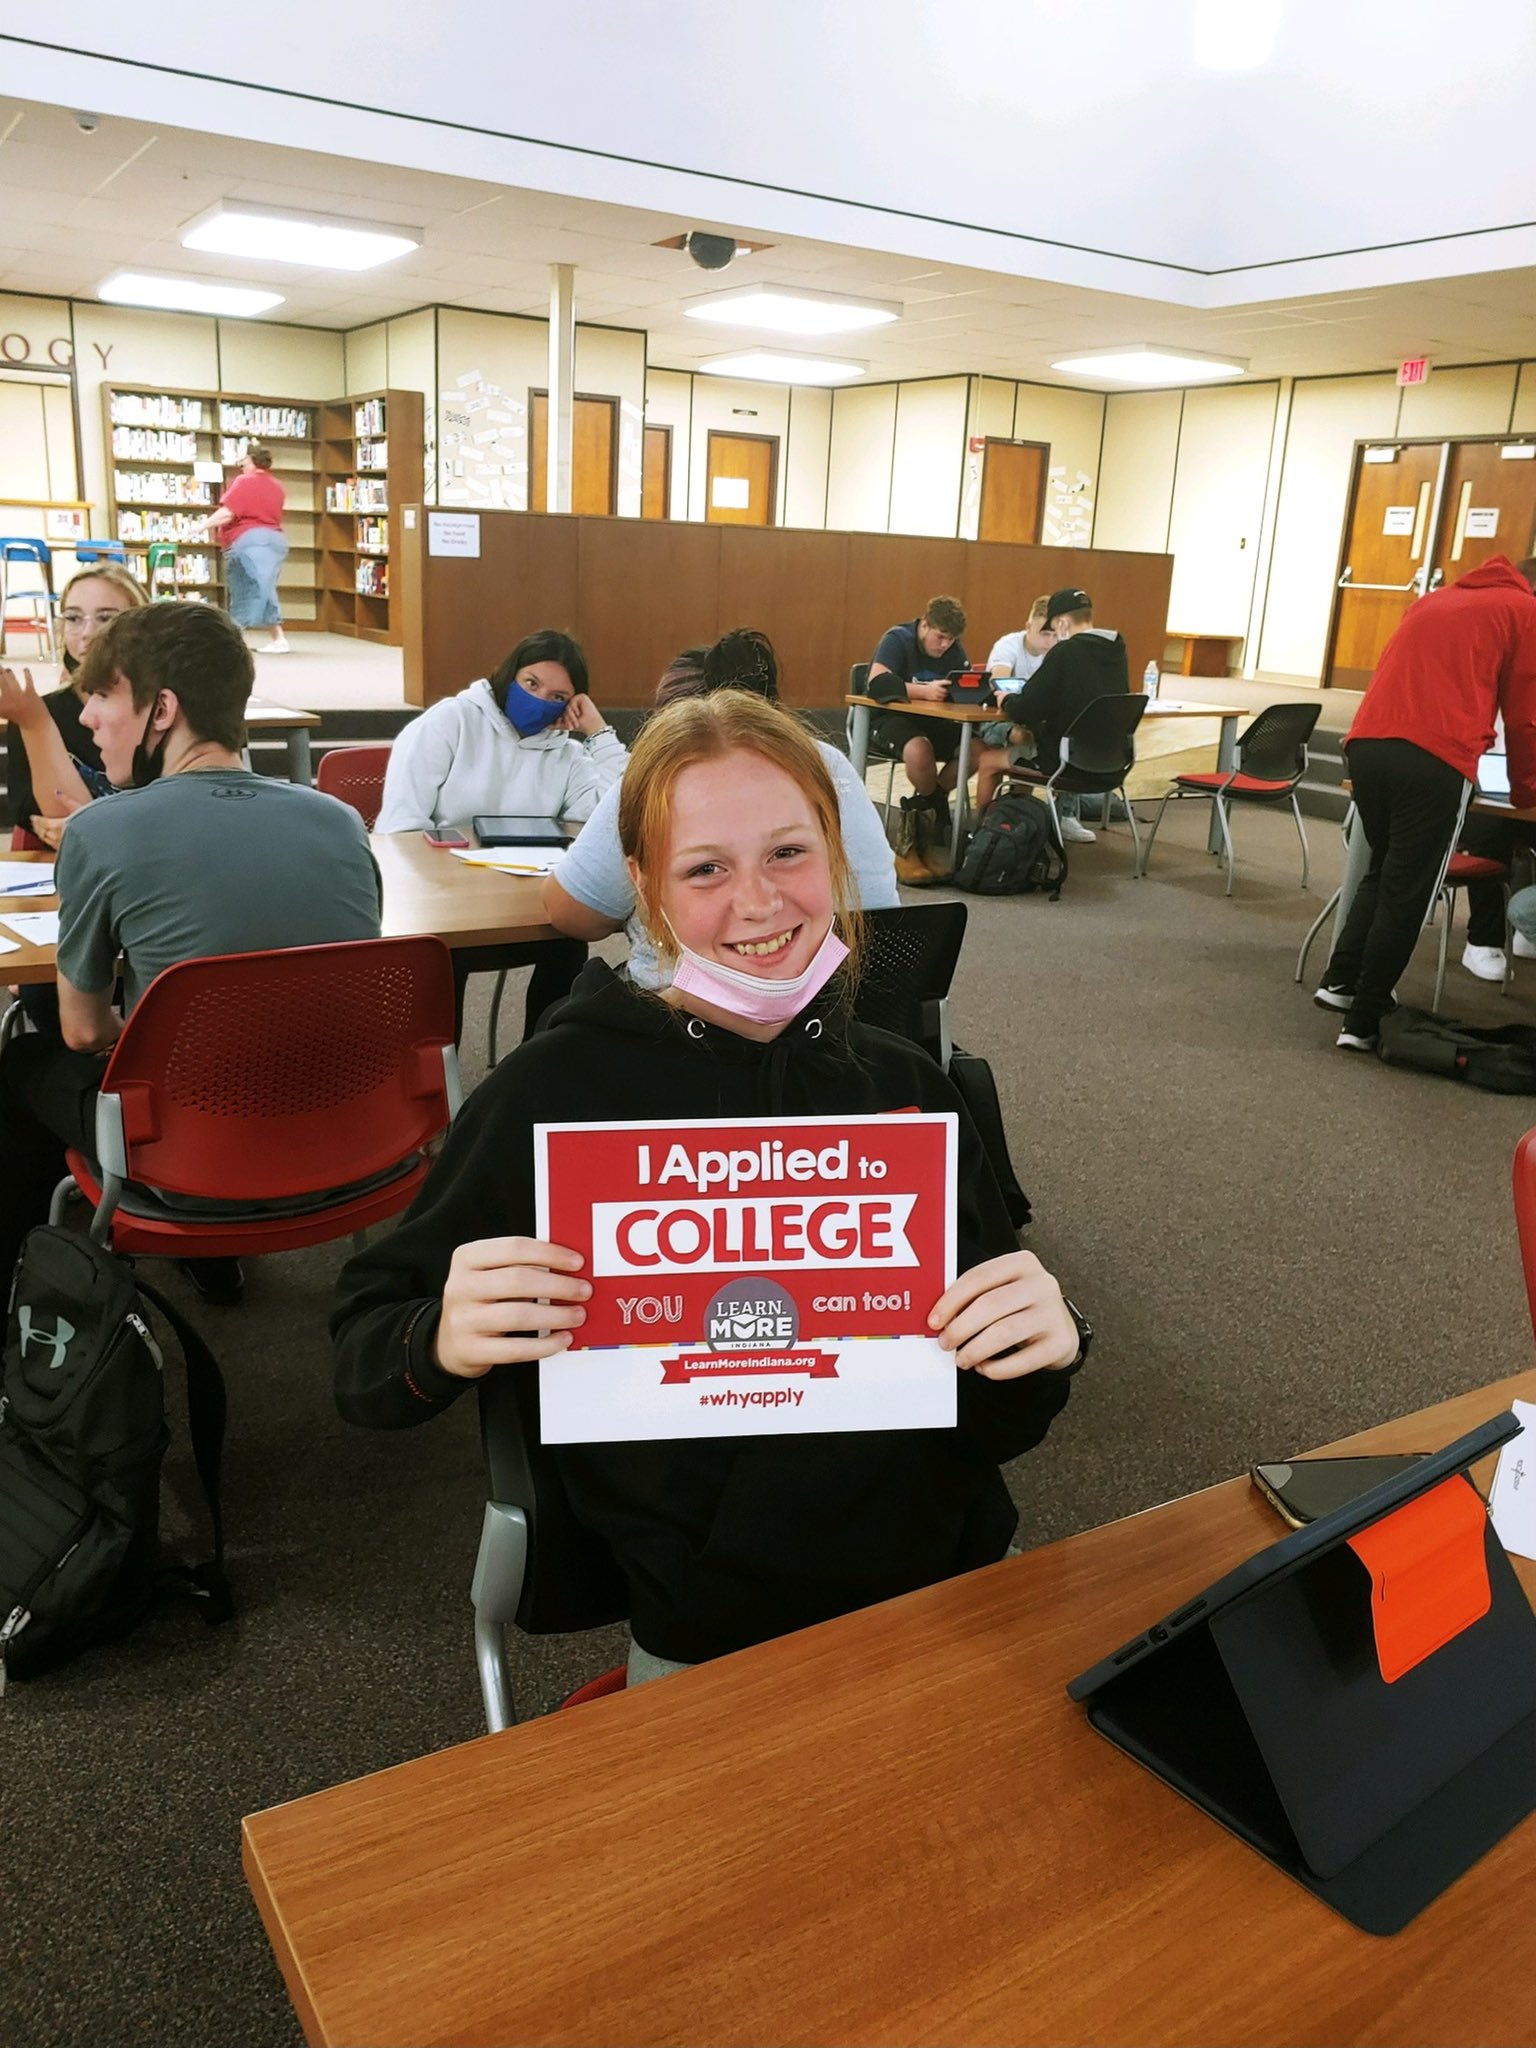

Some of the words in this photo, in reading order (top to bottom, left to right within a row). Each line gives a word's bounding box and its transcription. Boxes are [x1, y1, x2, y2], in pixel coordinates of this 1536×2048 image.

[1402, 361, 1425, 382] EXIT
[637, 1145, 650, 1184] I
[657, 1139, 849, 1193] Applied
[858, 1156, 887, 1179] to
[615, 1201, 893, 1266] COLLEGE
[616, 1296, 683, 1325] YOU
[812, 1294, 857, 1313] can
[862, 1290, 911, 1311] too!
[716, 1300, 783, 1317] LEARN
[710, 1316, 793, 1340] MORE
[683, 1356, 816, 1371] LearnMoreIndiana.org
[699, 1388, 805, 1409] #whyapply
